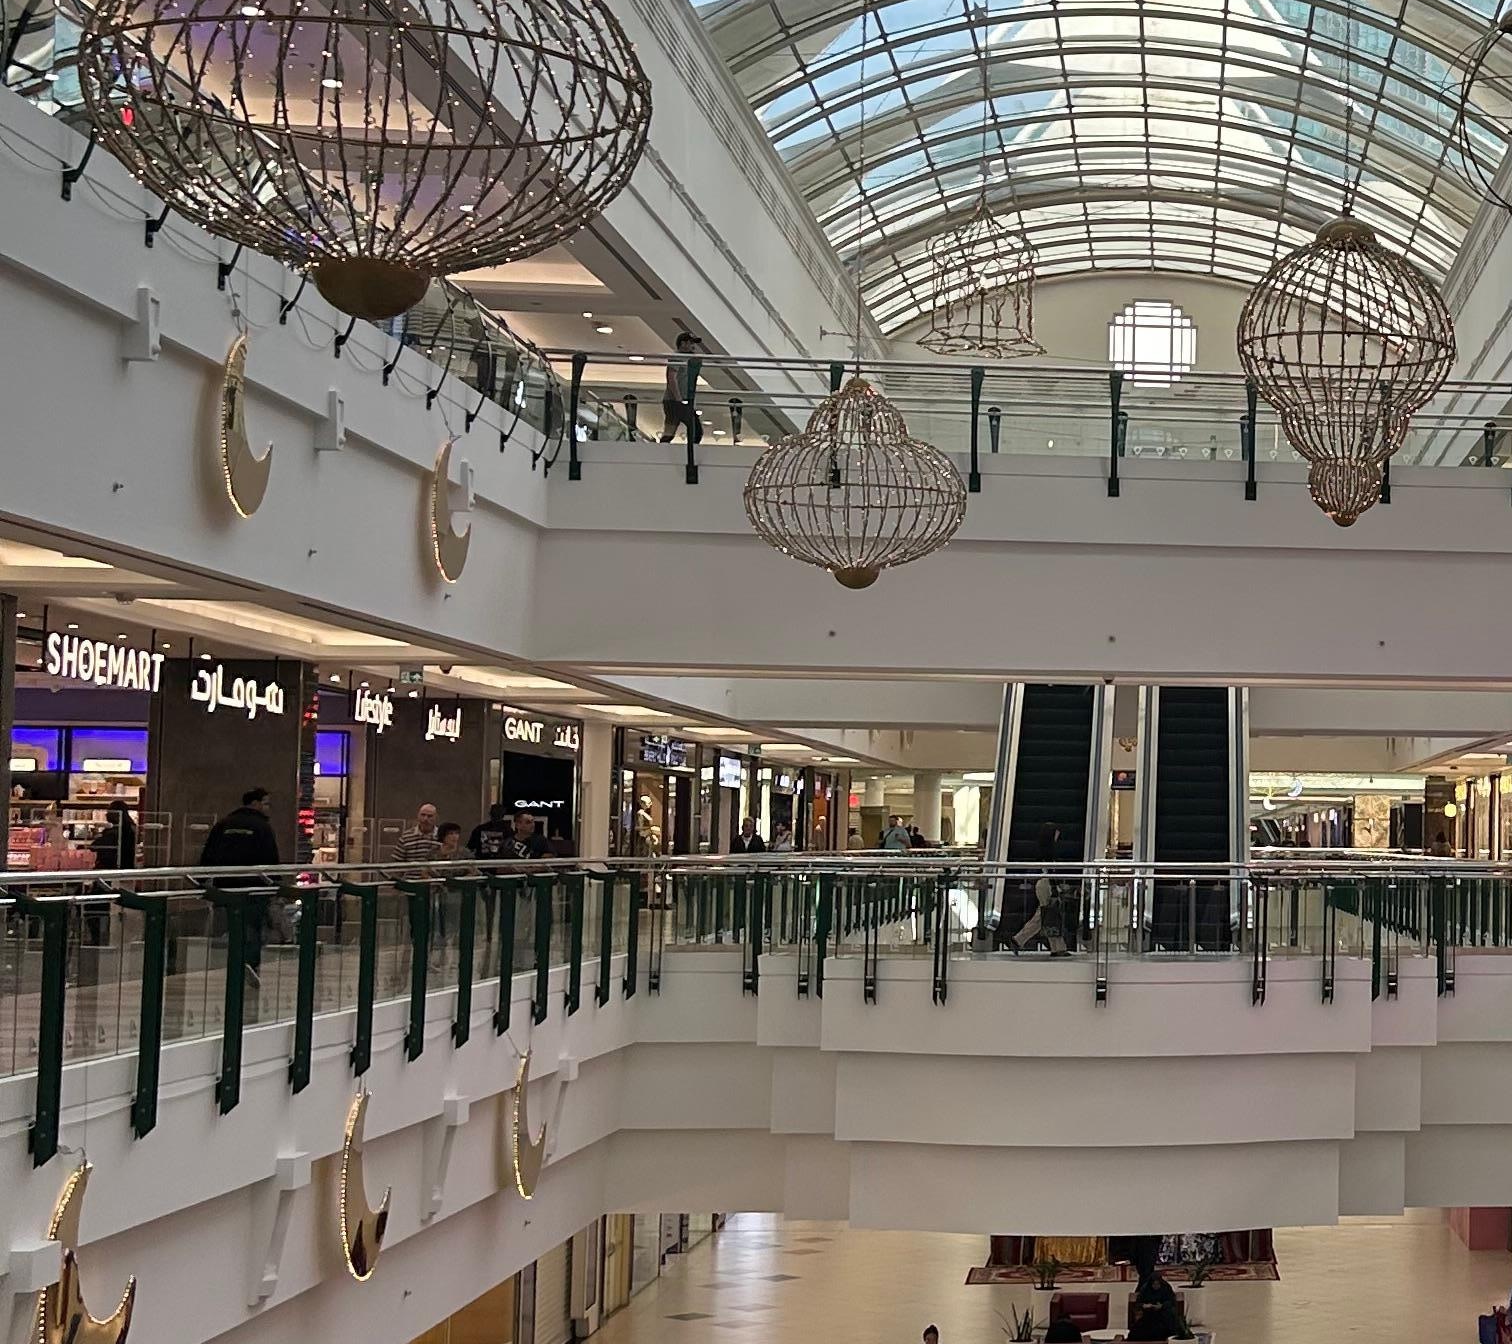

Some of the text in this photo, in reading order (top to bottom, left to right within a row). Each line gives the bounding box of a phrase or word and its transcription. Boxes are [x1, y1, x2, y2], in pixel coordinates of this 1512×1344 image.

[47, 632, 165, 692] SHOEMART
[504, 717, 544, 744] GANT
[514, 799, 565, 808] GANT
